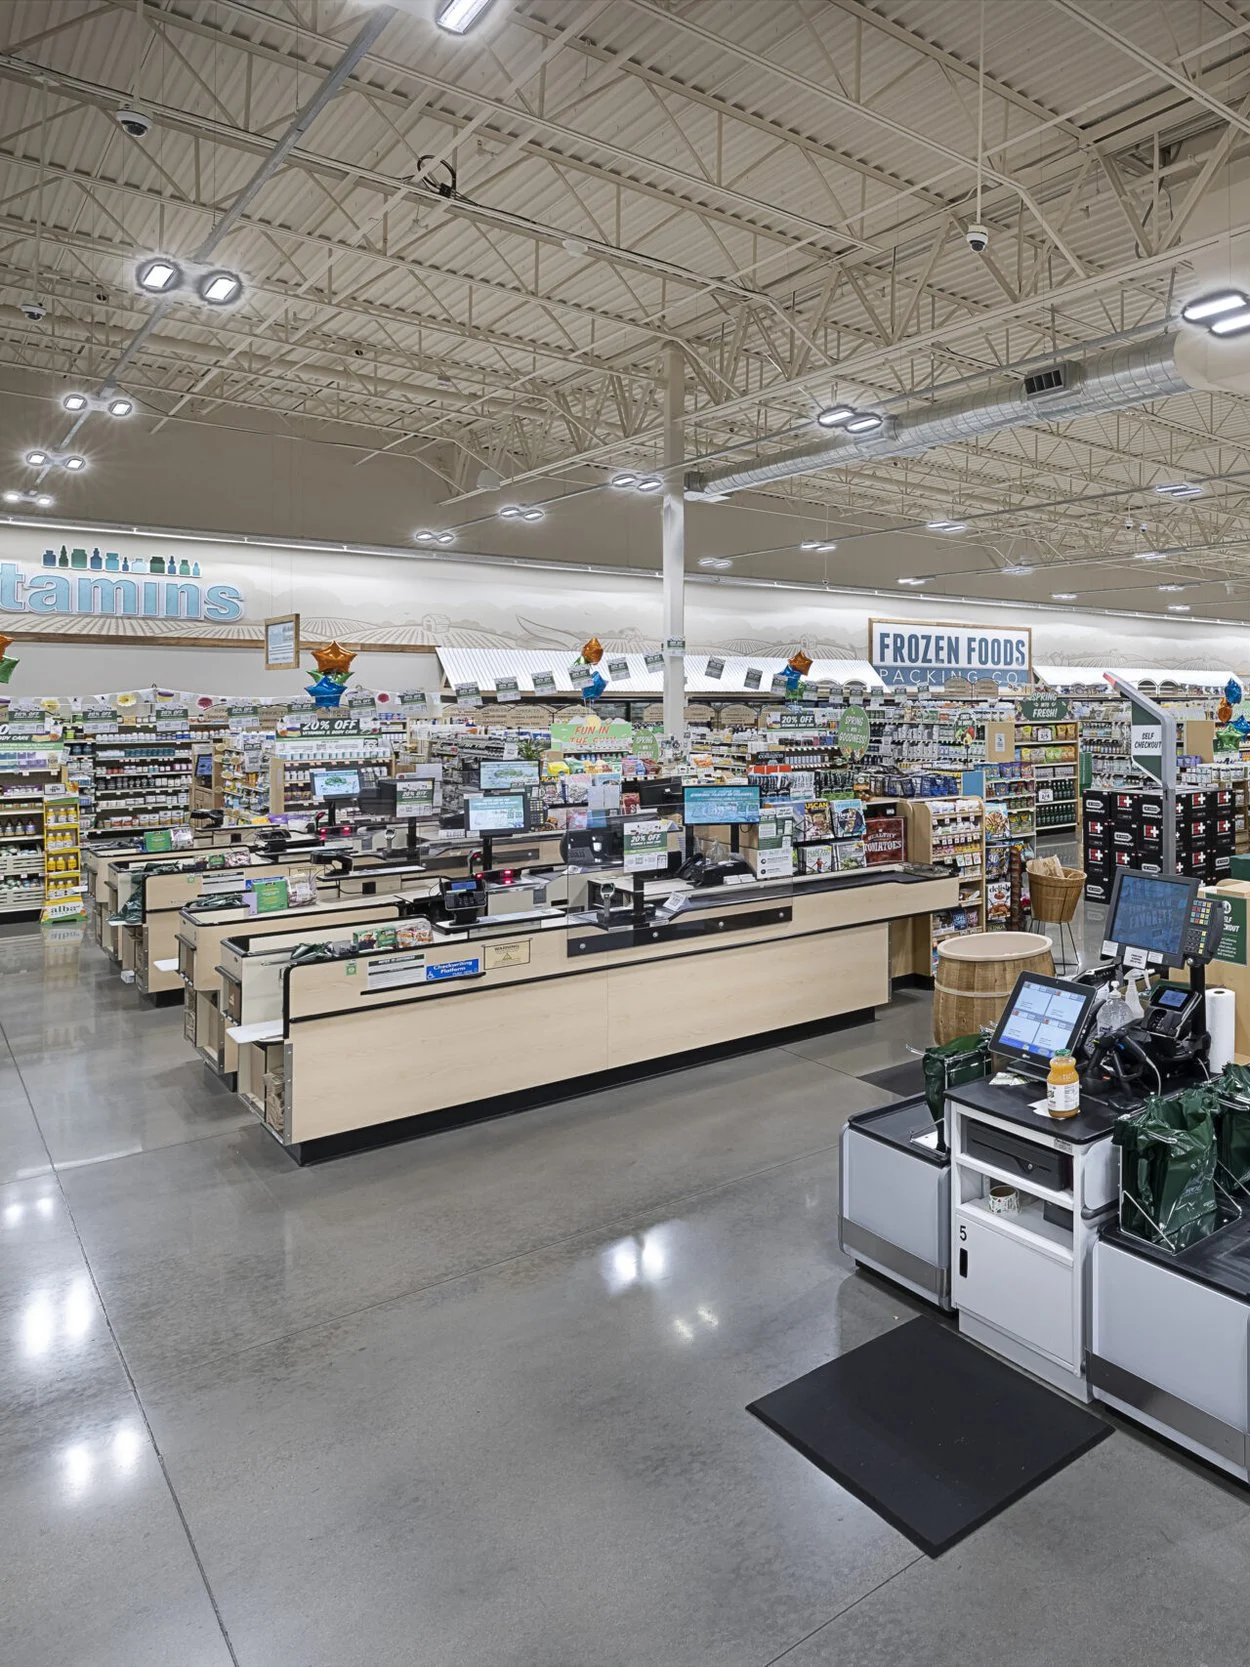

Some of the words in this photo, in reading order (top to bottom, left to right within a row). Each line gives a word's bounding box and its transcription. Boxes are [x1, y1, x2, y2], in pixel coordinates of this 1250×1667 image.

[879, 632, 960, 665] FROZEN
[967, 636, 1026, 667] FOODS
[879, 669, 978, 684] PACKING
[1031, 691, 1058, 702] SPRING
[1032, 708, 1058, 718] FRESH!
[781, 715, 798, 724] 20%
[800, 715, 814, 723] OFF
[302, 719, 330, 731] 20%
[334, 719, 358, 730] OFF
[574, 726, 596, 735] FUN
[598, 726, 610, 735] IN
[1141, 732, 1155, 740] SELF
[1134, 741, 1162, 749] CHECKOUT
[647, 833, 661, 841] OFF
[50, 905, 77, 914] alba
[433, 960, 473, 971] Checkwriting
[440, 966, 466, 975] Platform
[959, 1225, 968, 1242] 5
